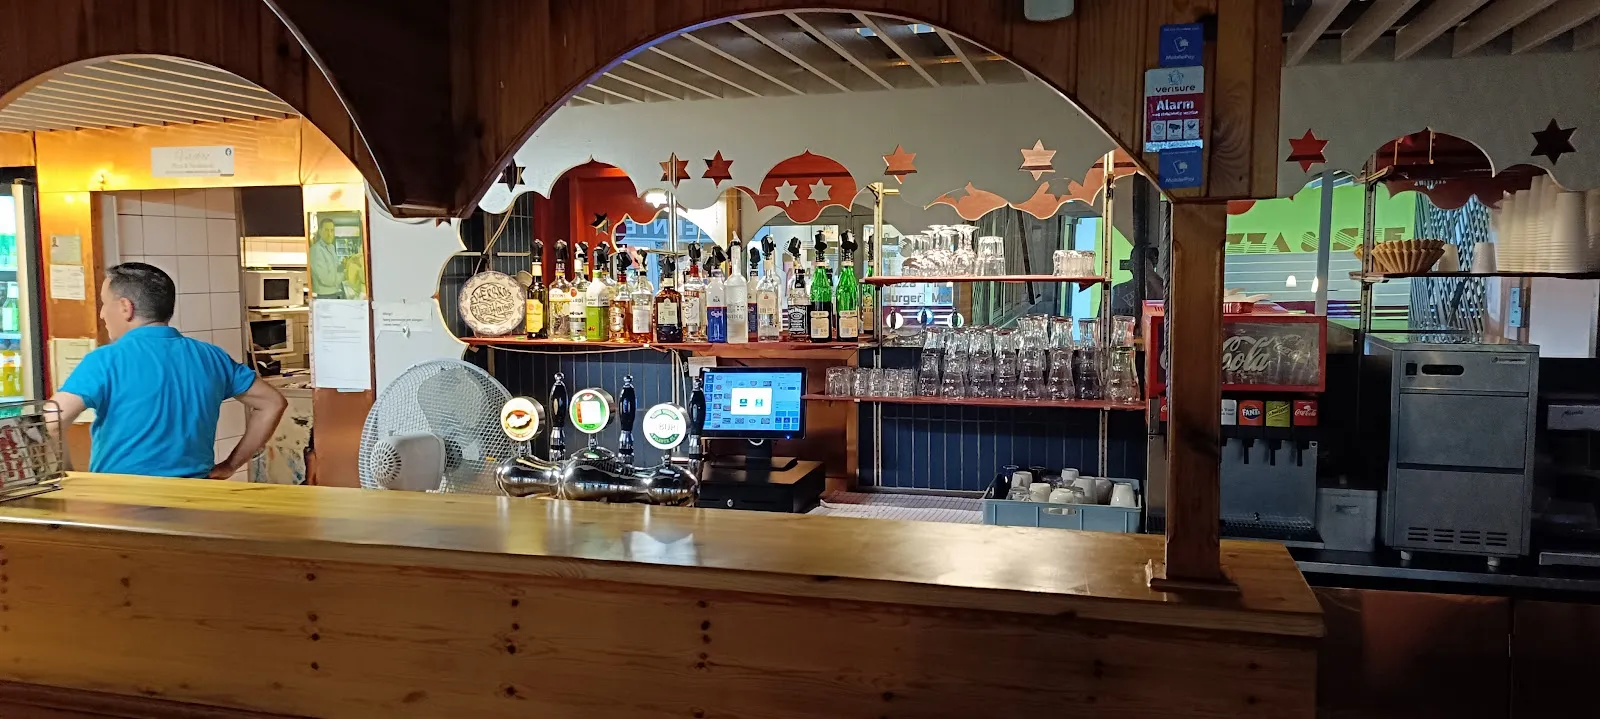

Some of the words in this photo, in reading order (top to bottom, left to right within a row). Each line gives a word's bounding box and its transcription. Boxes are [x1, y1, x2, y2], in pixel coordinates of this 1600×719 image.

[1155, 84, 1196, 93] verisure
[1156, 99, 1195, 111] Alarm
[1226, 231, 1291, 254] ZZA
